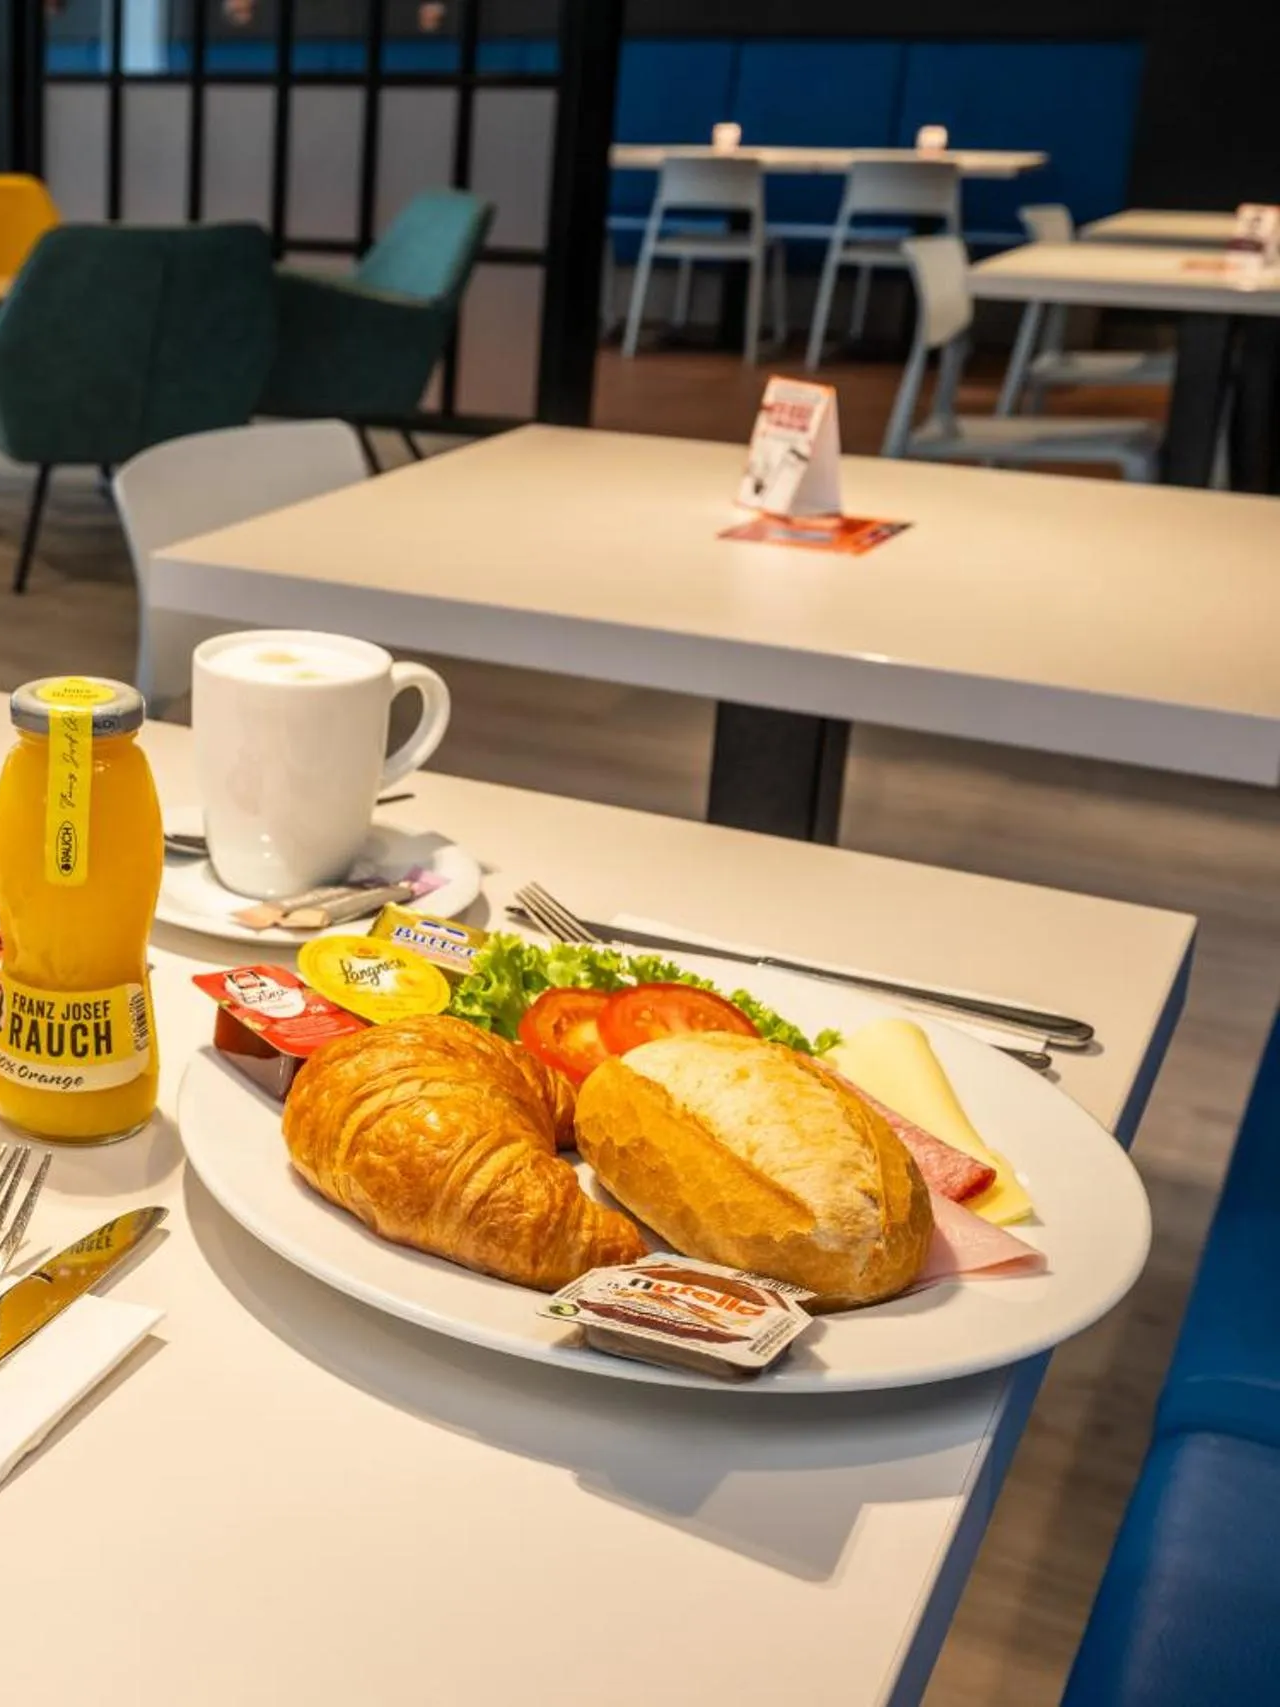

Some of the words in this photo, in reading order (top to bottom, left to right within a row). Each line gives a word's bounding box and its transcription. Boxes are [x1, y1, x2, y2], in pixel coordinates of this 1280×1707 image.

[61, 826, 73, 863] RAUCH
[394, 926, 477, 957] Butter
[12, 991, 56, 1021] FRANZ
[60, 1000, 111, 1022] JOSEF
[8, 1011, 114, 1059] RAUCH
[17, 1064, 85, 1090] Orange
[628, 1277, 766, 1317] nutella
